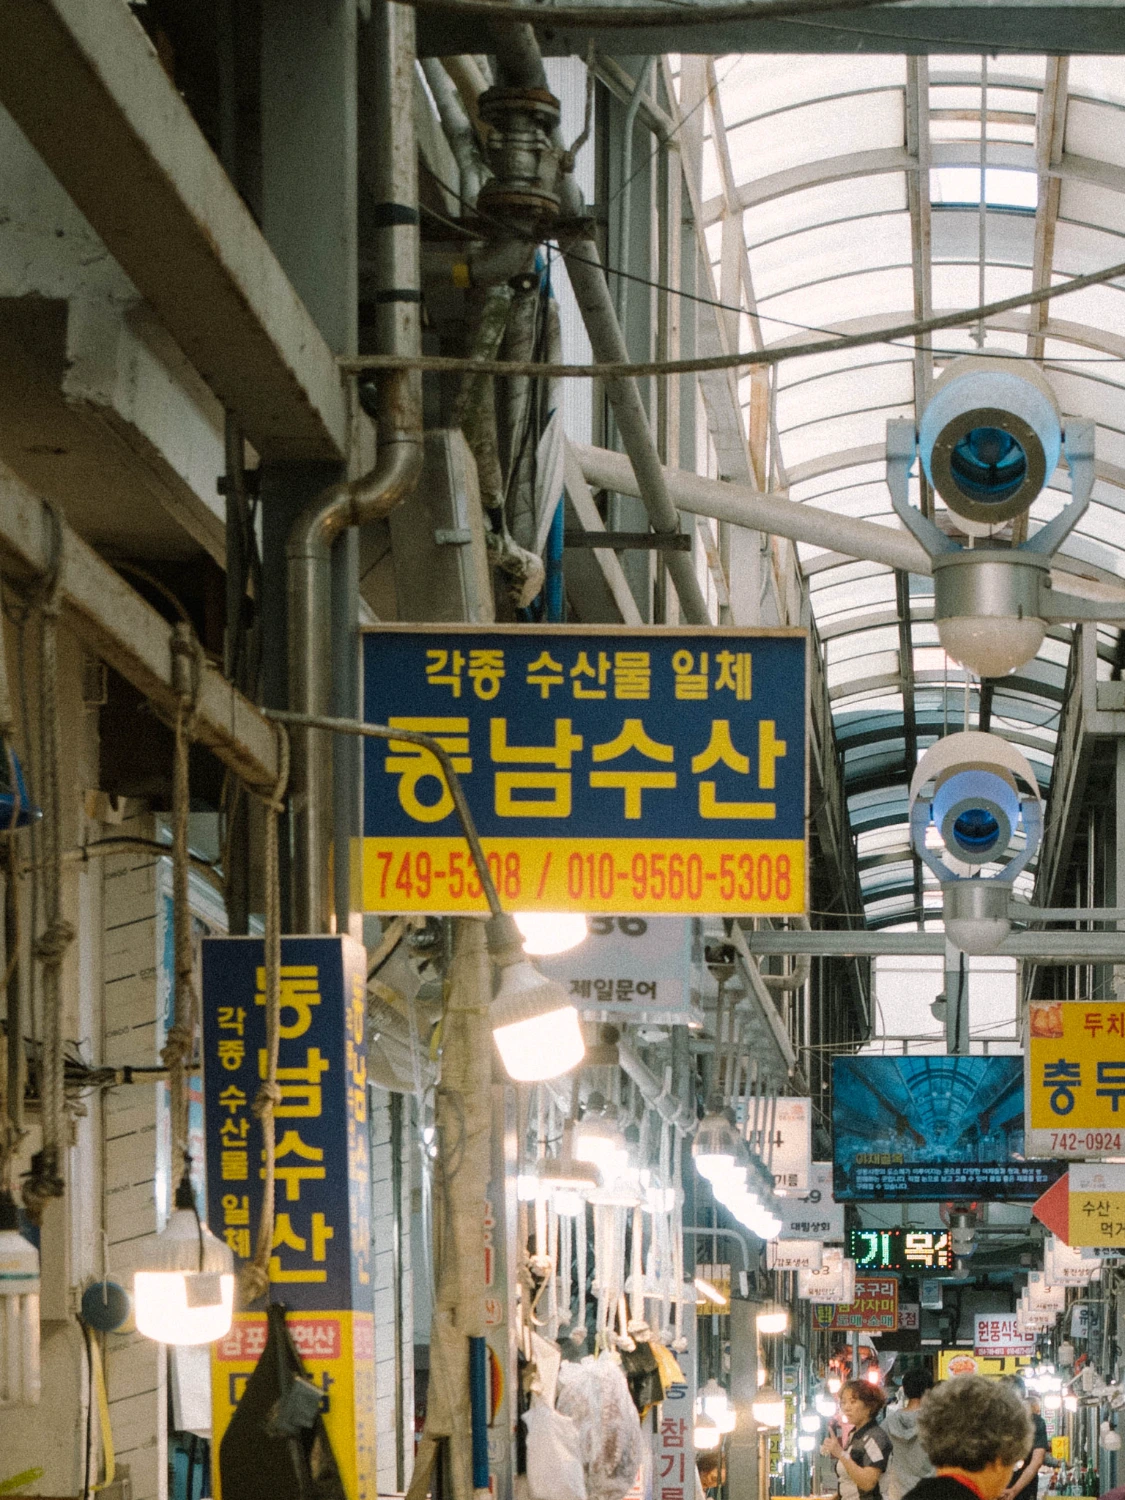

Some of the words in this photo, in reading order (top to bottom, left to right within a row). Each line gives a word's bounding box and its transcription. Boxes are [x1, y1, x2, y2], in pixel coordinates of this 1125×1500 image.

[425, 649, 506, 701] 각종
[526, 651, 652, 700] 수산물
[672, 650, 753, 701] 일체
[384, 716, 787, 824] 동남수산
[376, 851, 522, 900] 749-5308
[567, 853, 792, 901] 010-9560-5308
[569, 979, 657, 1002] 제일문어
[217, 1006, 247, 1072] 각종
[1083, 1012, 1125, 1038] 두치
[219, 1085, 251, 1181] 수산물
[254, 965, 334, 1284] 동남수산
[1050, 1133, 1122, 1151] 742-0924
[1082, 1200, 1111, 1218] 수산
[221, 1195, 252, 1259] 일체
[776, 1258, 810, 1267] 감포생선
[861, 1233, 890, 1265] 기
[854, 1282, 894, 1297] 주구리
[222, 1326, 265, 1356] 감포
